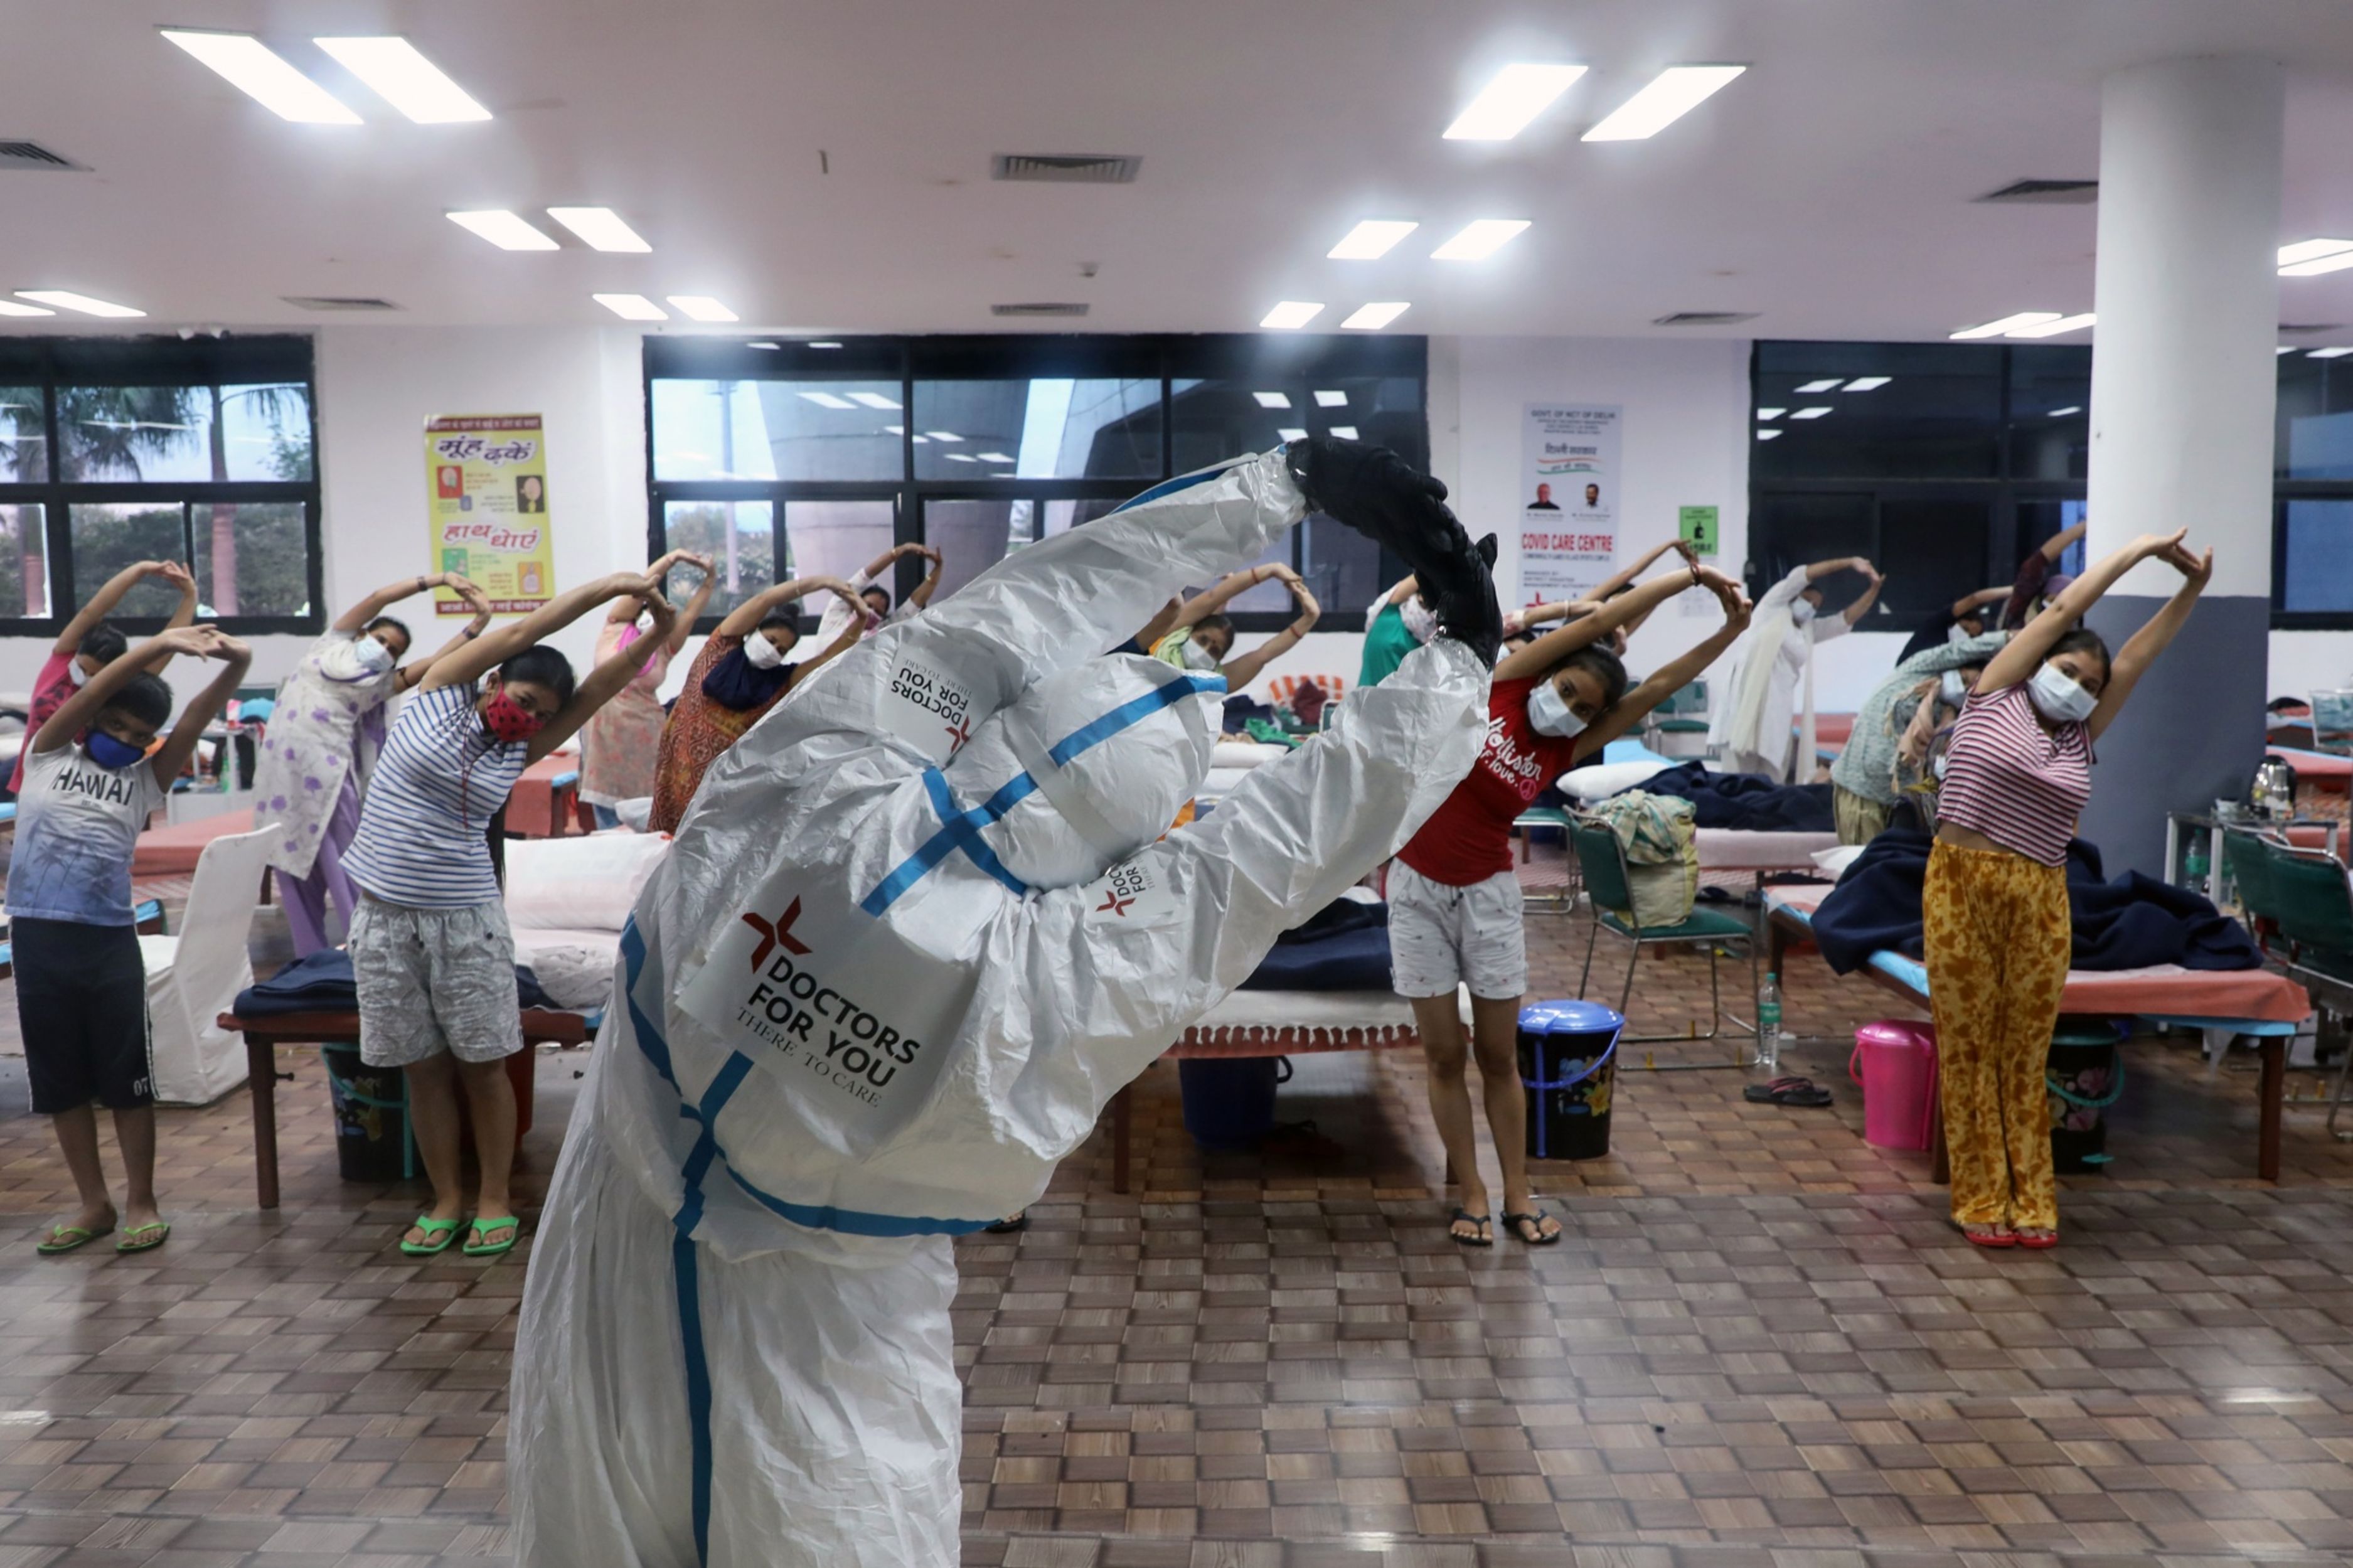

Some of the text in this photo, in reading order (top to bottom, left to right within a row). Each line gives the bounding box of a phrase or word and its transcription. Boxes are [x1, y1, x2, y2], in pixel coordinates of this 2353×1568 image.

[444, 525, 492, 541] हाथ
[1522, 533, 1613, 552] COVID CARE CENTRE
[891, 680, 962, 725] DOCTORS
[899, 668, 968, 711] FOR YOU
[52, 768, 134, 806] HAWAI
[1126, 867, 1146, 892] FOR
[767, 955, 920, 1065] DOCTORS
[748, 983, 897, 1087] FOR YOU
[736, 1006, 882, 1108] THERE TO CARE
